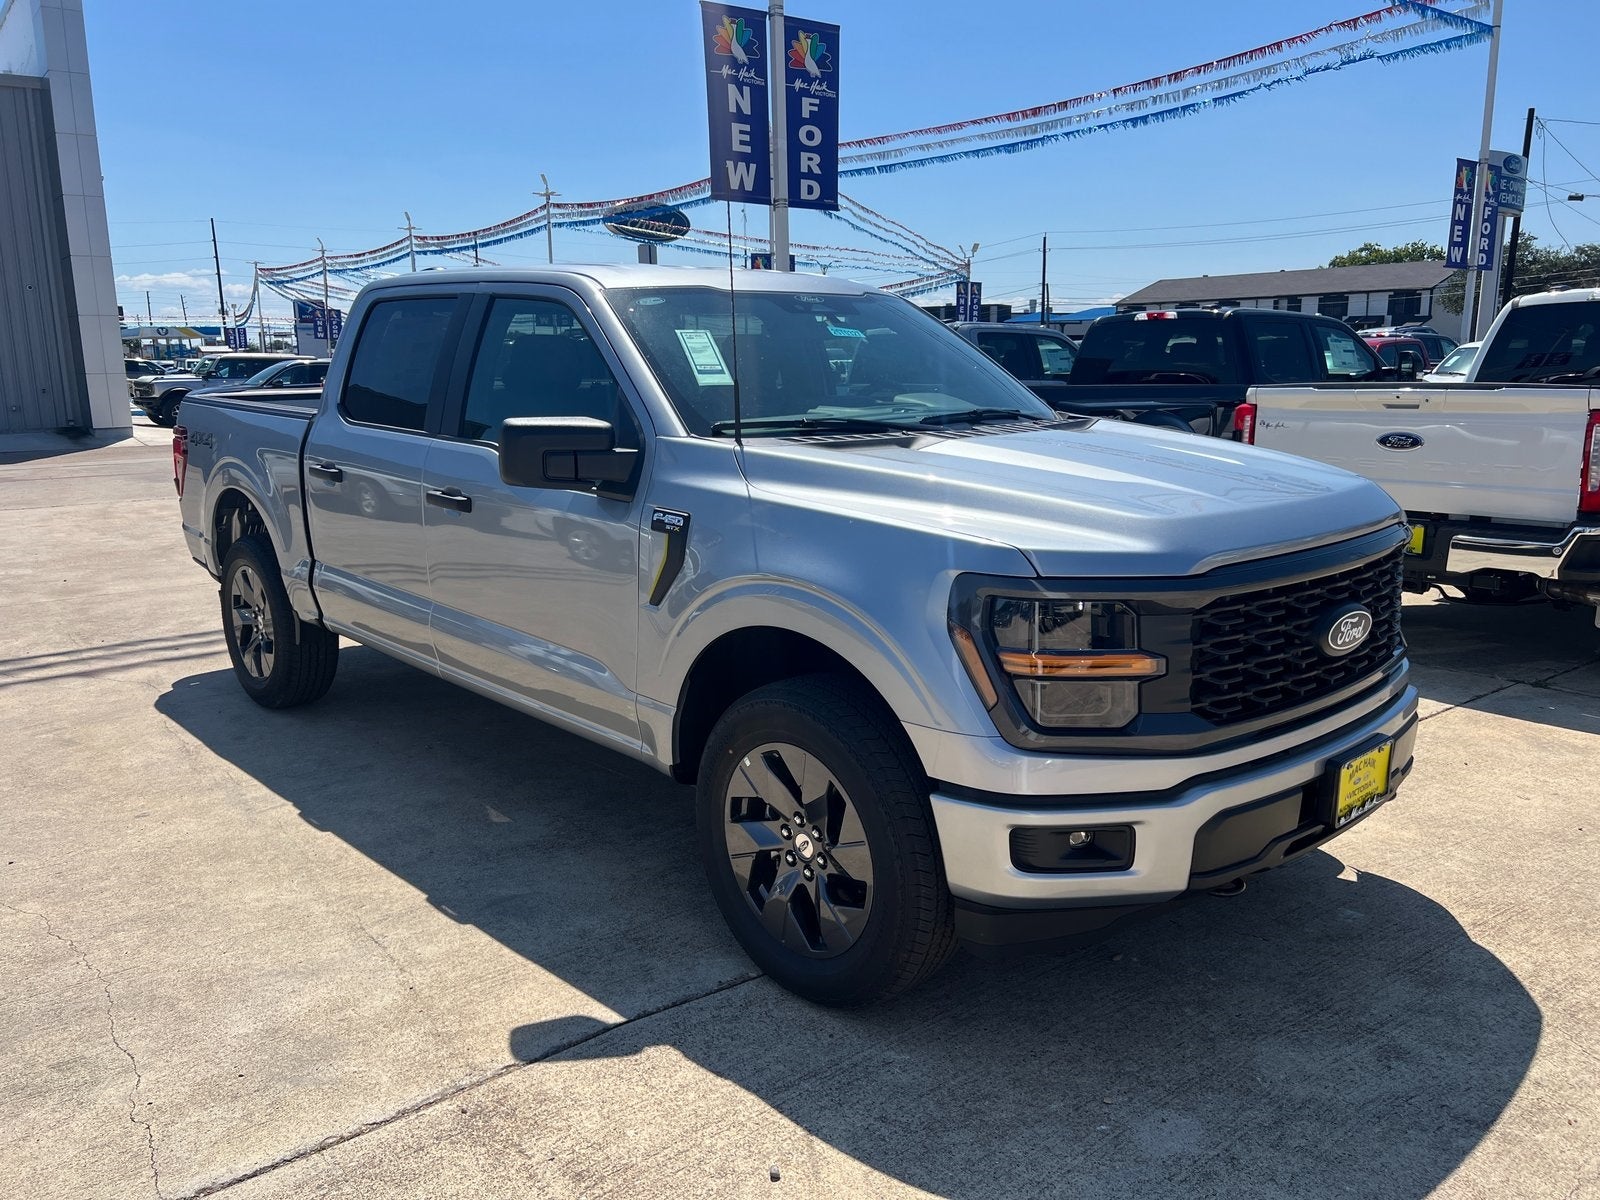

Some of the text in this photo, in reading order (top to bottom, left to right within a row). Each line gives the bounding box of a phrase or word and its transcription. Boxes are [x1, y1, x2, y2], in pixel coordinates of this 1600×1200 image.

[743, 77, 765, 86] VICTORIA
[815, 90, 836, 98] VICTORIA
[727, 83, 756, 191] NEW
[799, 96, 822, 201] FORD
[1450, 203, 1466, 263] NEW
[1478, 206, 1492, 265] FORD
[1336, 616, 1365, 645] Ford
